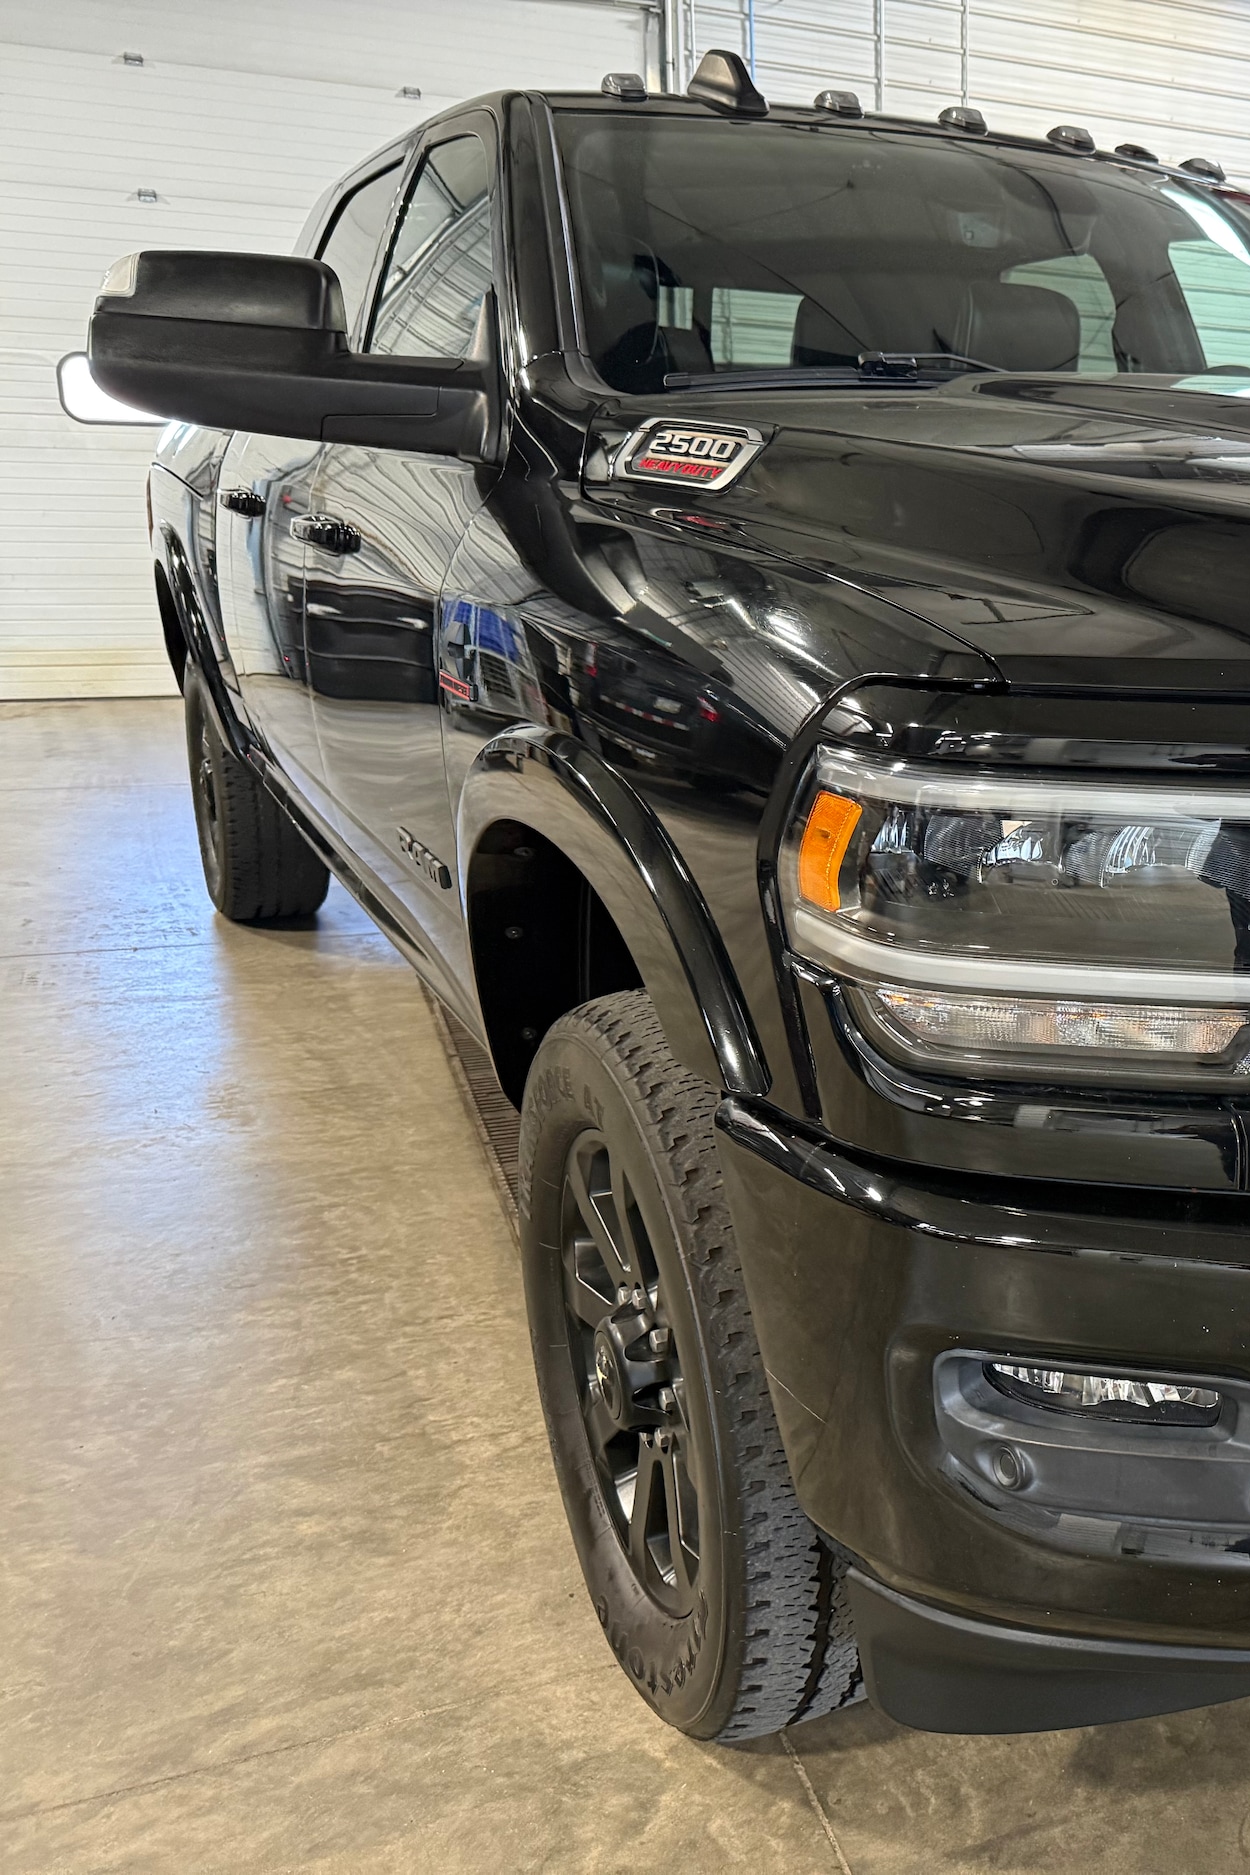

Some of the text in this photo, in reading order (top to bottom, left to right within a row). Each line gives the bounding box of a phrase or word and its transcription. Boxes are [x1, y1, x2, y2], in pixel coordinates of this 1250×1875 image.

[648, 432, 738, 460] 2500
[638, 458, 723, 479] HEAVY DUTY
[396, 826, 452, 889] RAM
